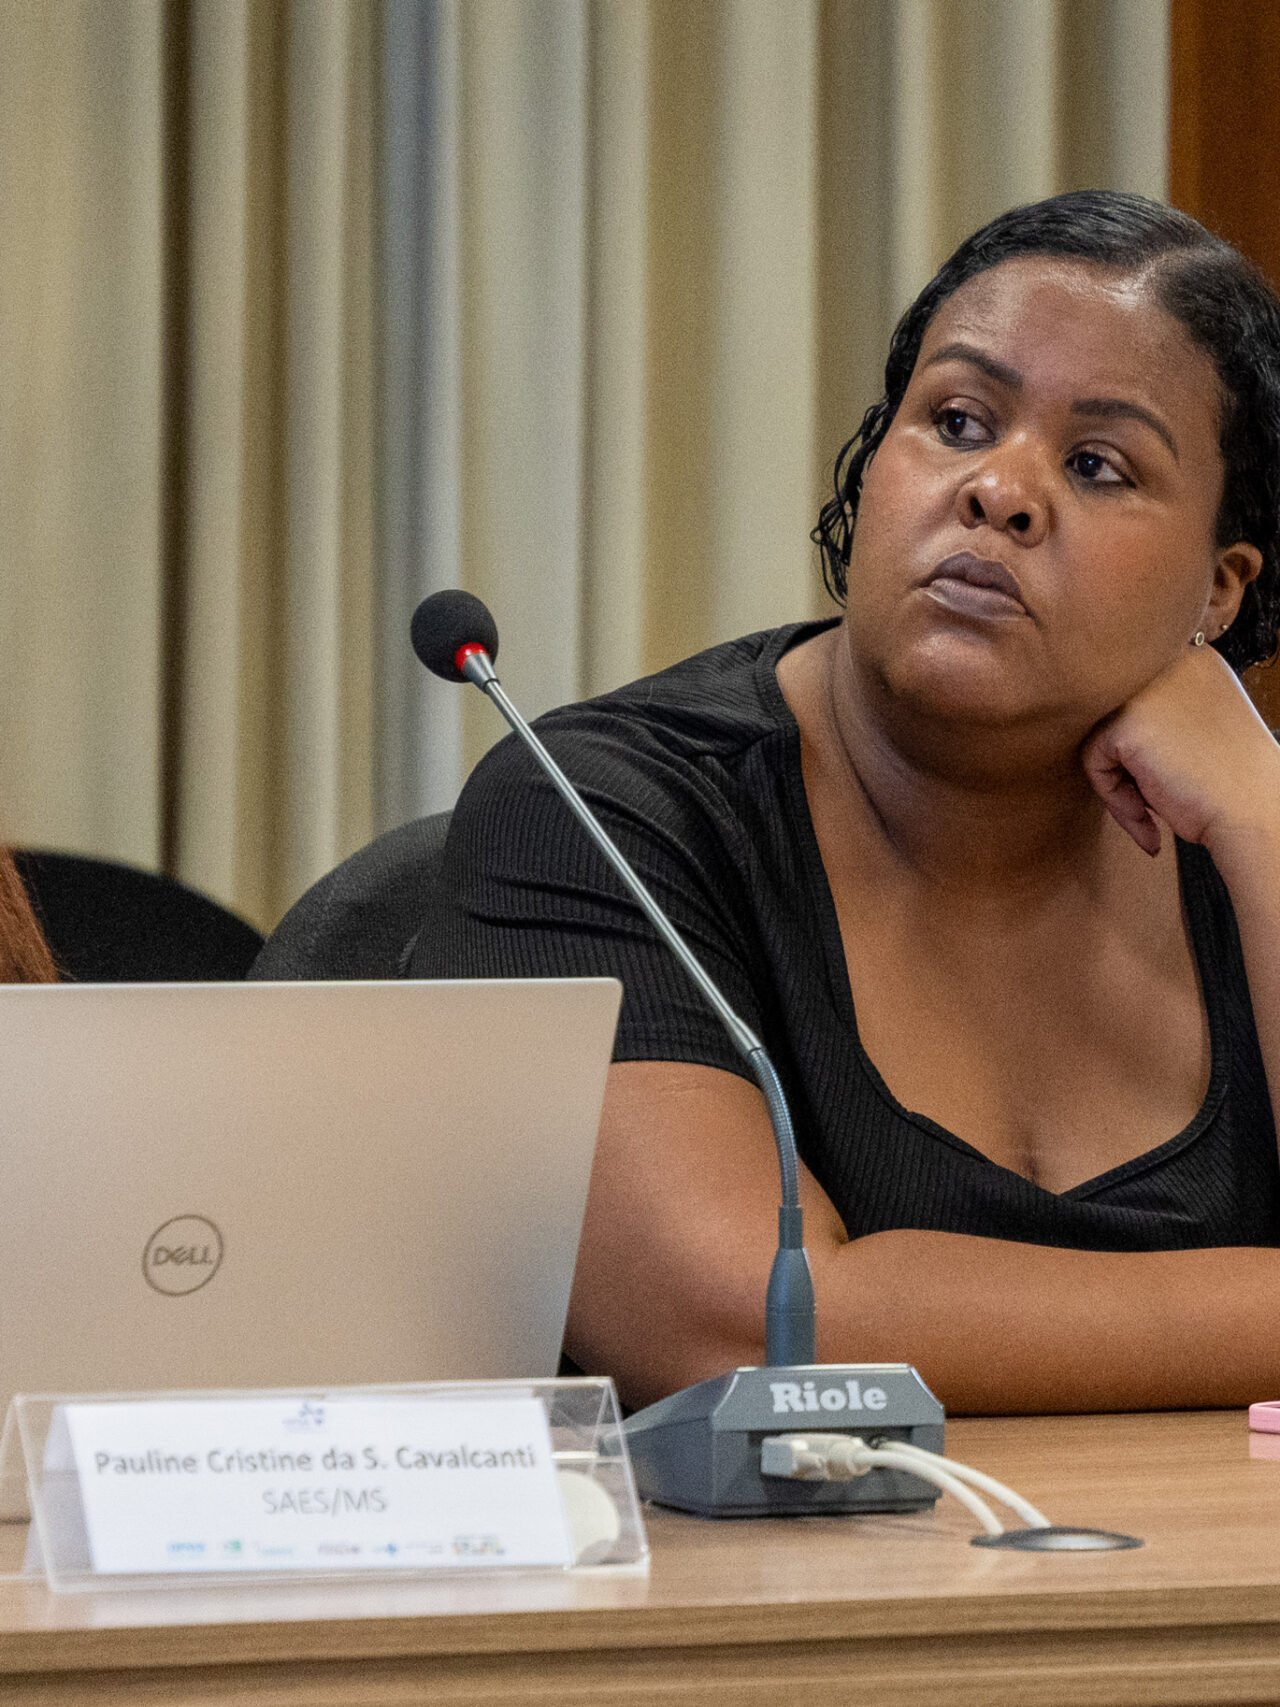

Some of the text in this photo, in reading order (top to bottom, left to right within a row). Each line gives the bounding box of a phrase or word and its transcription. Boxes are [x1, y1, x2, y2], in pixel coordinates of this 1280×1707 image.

[152, 1246, 213, 1266] DELL
[769, 1380, 888, 1413] Riole
[95, 1444, 536, 1475] Pauline Cristine da S. Cavalcanti
[262, 1488, 388, 1517] SAES/MS
